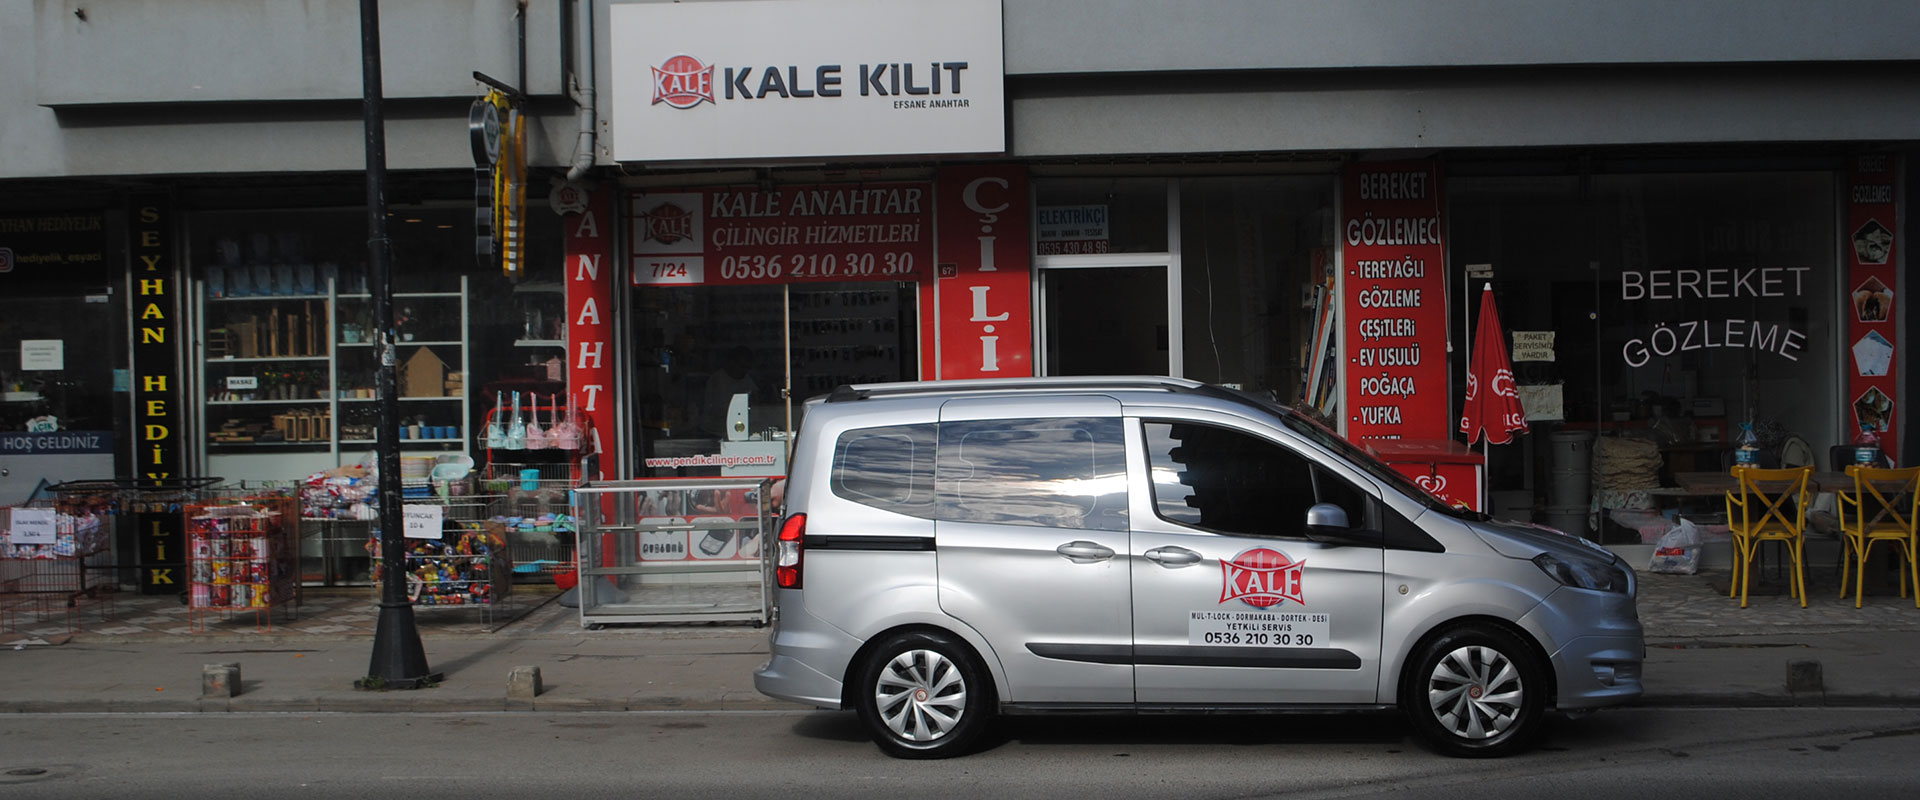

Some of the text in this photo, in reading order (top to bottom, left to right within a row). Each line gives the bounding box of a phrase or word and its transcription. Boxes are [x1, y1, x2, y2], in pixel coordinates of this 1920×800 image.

[724, 65, 842, 99] KALE
[893, 99, 970, 109] EFSANE ANAHTAR
[1360, 172, 1427, 200] BEREKET
[709, 188, 923, 218] KALE ANAHTAR
[0, 217, 34, 232] YHAN
[1039, 206, 1105, 226] ELEKTRİKÇİ
[711, 218, 920, 251] ÇİLİNGİR HİZMETLERİ
[1346, 211, 1441, 247] GÖZLEMECİ
[1039, 240, 1107, 254] 0535 430 48 96
[139, 207, 166, 344] SEYHAN
[650, 262, 687, 277] 7/24
[720, 251, 914, 280] 0536 210 30 30
[1357, 255, 1425, 279] TEREYAĞLI
[1622, 267, 1811, 301] BEREKET
[1359, 286, 1421, 308] GÖZLEME
[1359, 343, 1421, 366] EV USULÜ
[1623, 319, 1807, 368] GÖZLEME
[1360, 373, 1416, 399] POĞAÇA
[1360, 406, 1402, 425] YUFKA
[3, 433, 100, 453] HOŞ GELDİNİZ
[645, 454, 775, 468] www.pendikcilingir.com.tr
[143, 375, 174, 585] HEDİYLİK
[1223, 564, 1302, 601] KALE
[1191, 612, 1231, 621] MUL-T-LOCK
[1235, 613, 1276, 622] DORMAKABA
[1281, 614, 1307, 623] DORTEK
[1204, 632, 1314, 646] 0536 210 30 30
